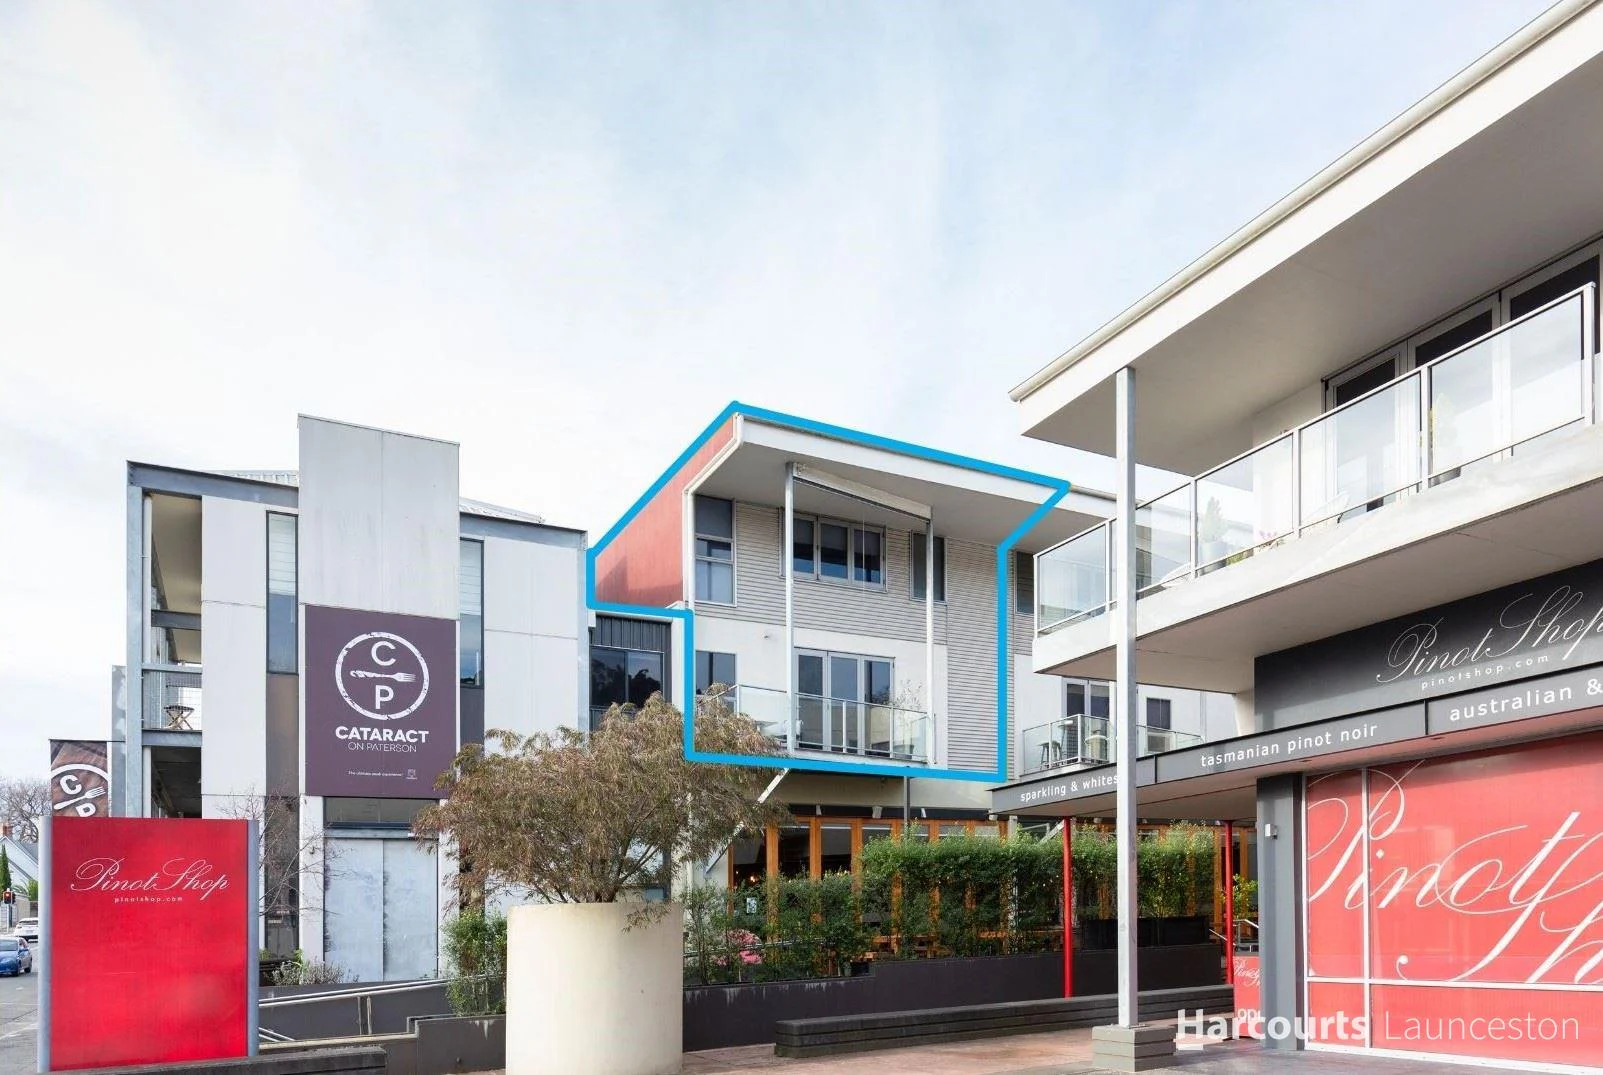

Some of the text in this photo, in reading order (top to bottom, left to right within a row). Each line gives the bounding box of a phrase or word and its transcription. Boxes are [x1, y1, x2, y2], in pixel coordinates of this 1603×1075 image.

[371, 640, 396, 666] C
[1376, 617, 1494, 684] Pinot
[1421, 653, 1549, 691] pinotshop.com
[375, 685, 394, 710] P
[1449, 686, 1572, 722] australian
[335, 725, 429, 744] CATARACT
[347, 741, 417, 753] ON PATERSON
[1201, 723, 1378, 767] tasmanian pinot noir
[60, 774, 82, 795] C
[1020, 774, 1118, 803] sparkling & whites
[70, 856, 229, 901] Pinot Shop
